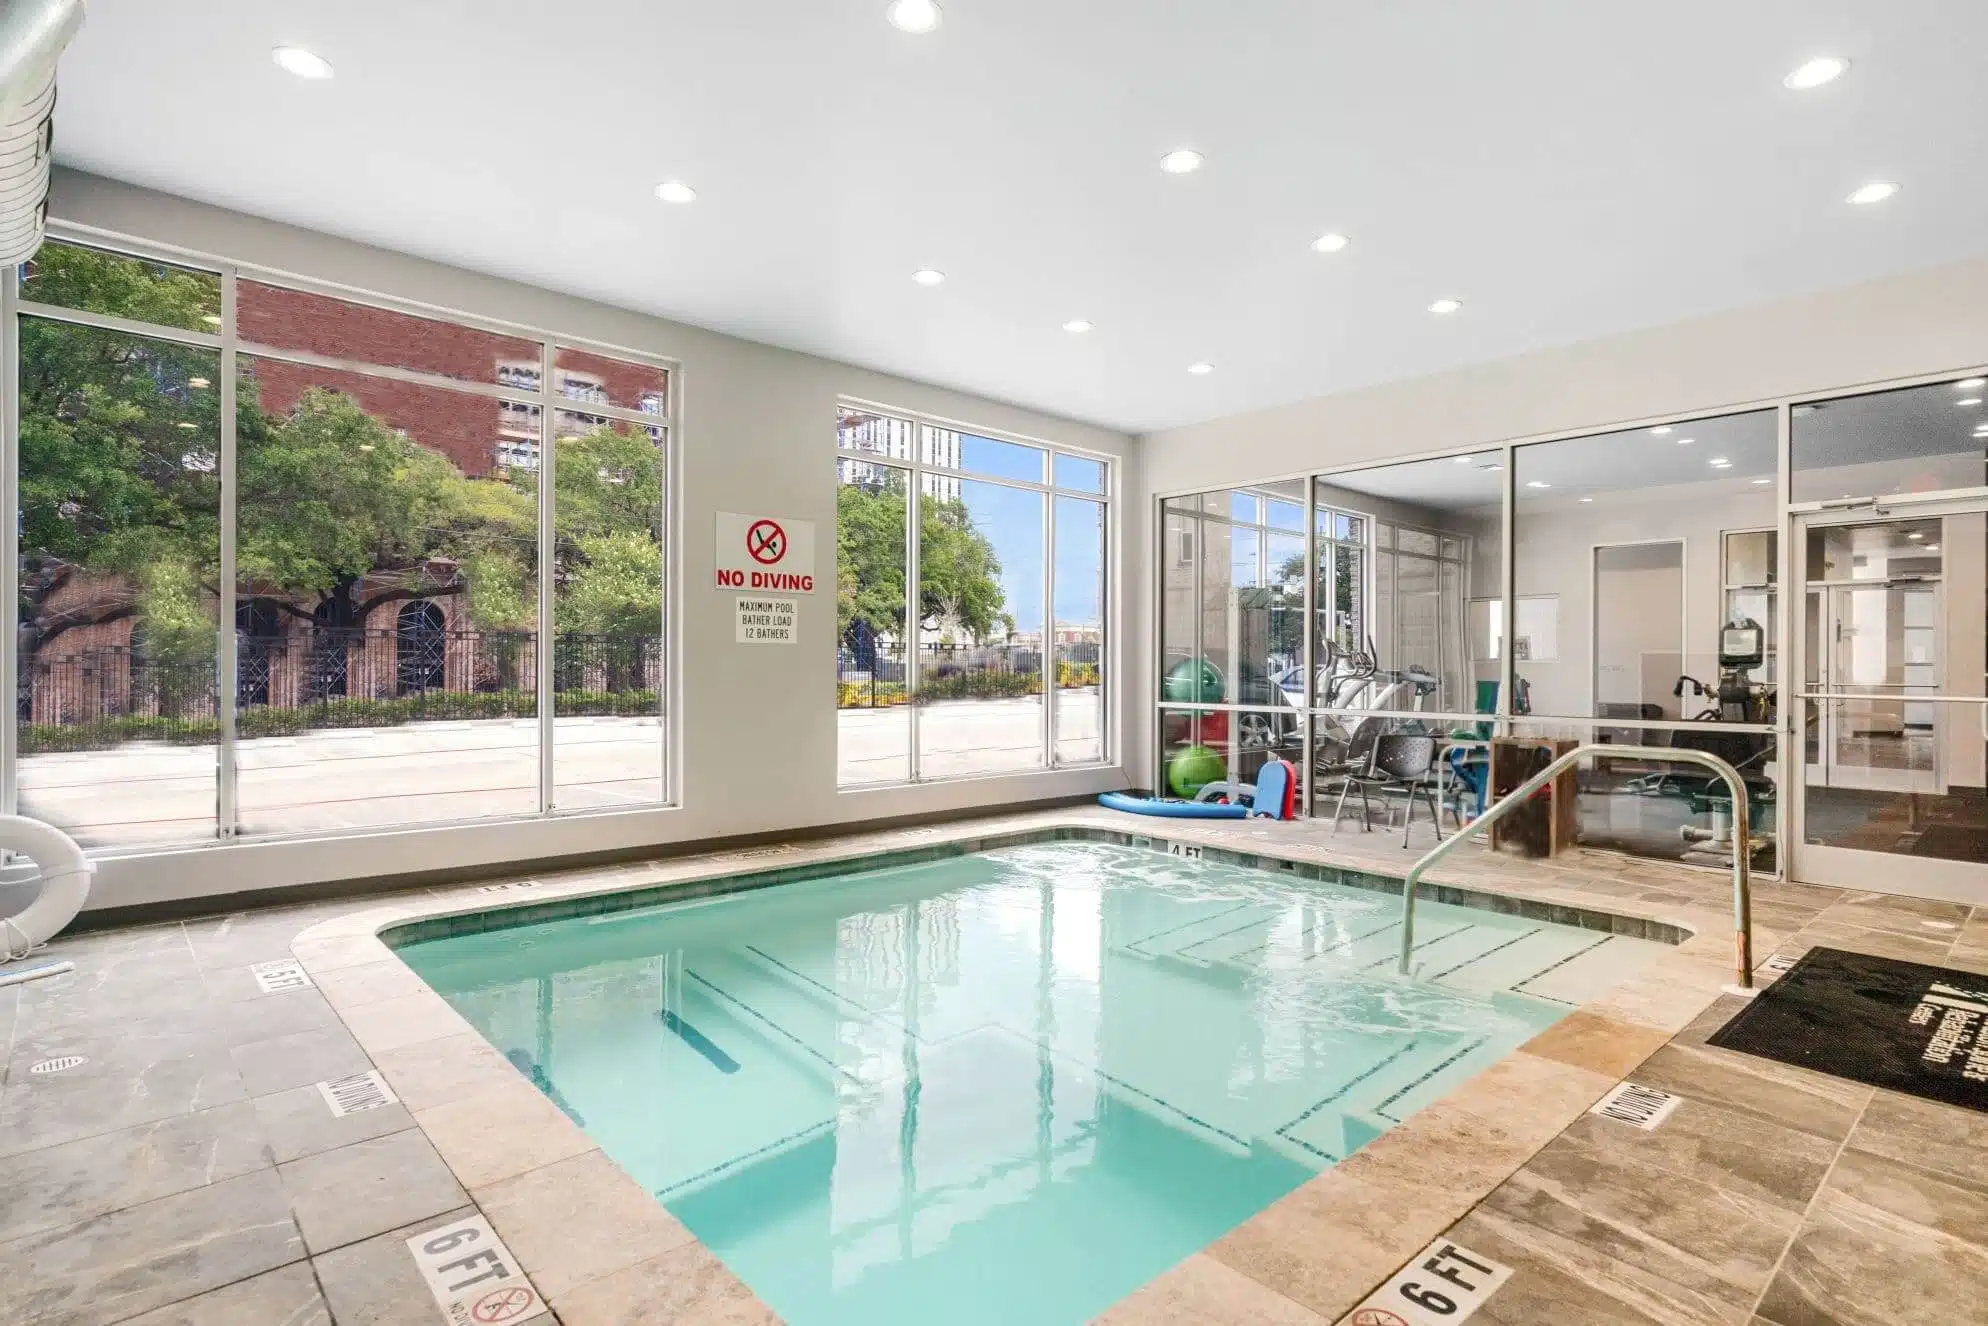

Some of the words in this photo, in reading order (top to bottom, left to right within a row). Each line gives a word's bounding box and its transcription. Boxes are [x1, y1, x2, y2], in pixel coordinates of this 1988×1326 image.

[717, 569, 745, 587] NO
[751, 572, 813, 591] DIVING
[739, 601, 773, 613] MAXIMUM
[775, 602, 795, 614] POOL
[742, 615, 770, 625] BATHER
[773, 616, 792, 626] LOAD
[745, 628, 754, 639] 12
[756, 628, 789, 639] BATHERS
[1185, 846, 1201, 858] FT
[267, 976, 305, 990] FT
[327, 1072, 373, 1089] NO
[332, 1082, 388, 1113] DIVING
[1611, 1085, 1671, 1116] DIVING
[1600, 1106, 1649, 1127] NO
[423, 1227, 480, 1255] 6
[437, 1248, 511, 1293] FT
[1422, 1244, 1494, 1292] FT
[1400, 1281, 1458, 1315] 6
